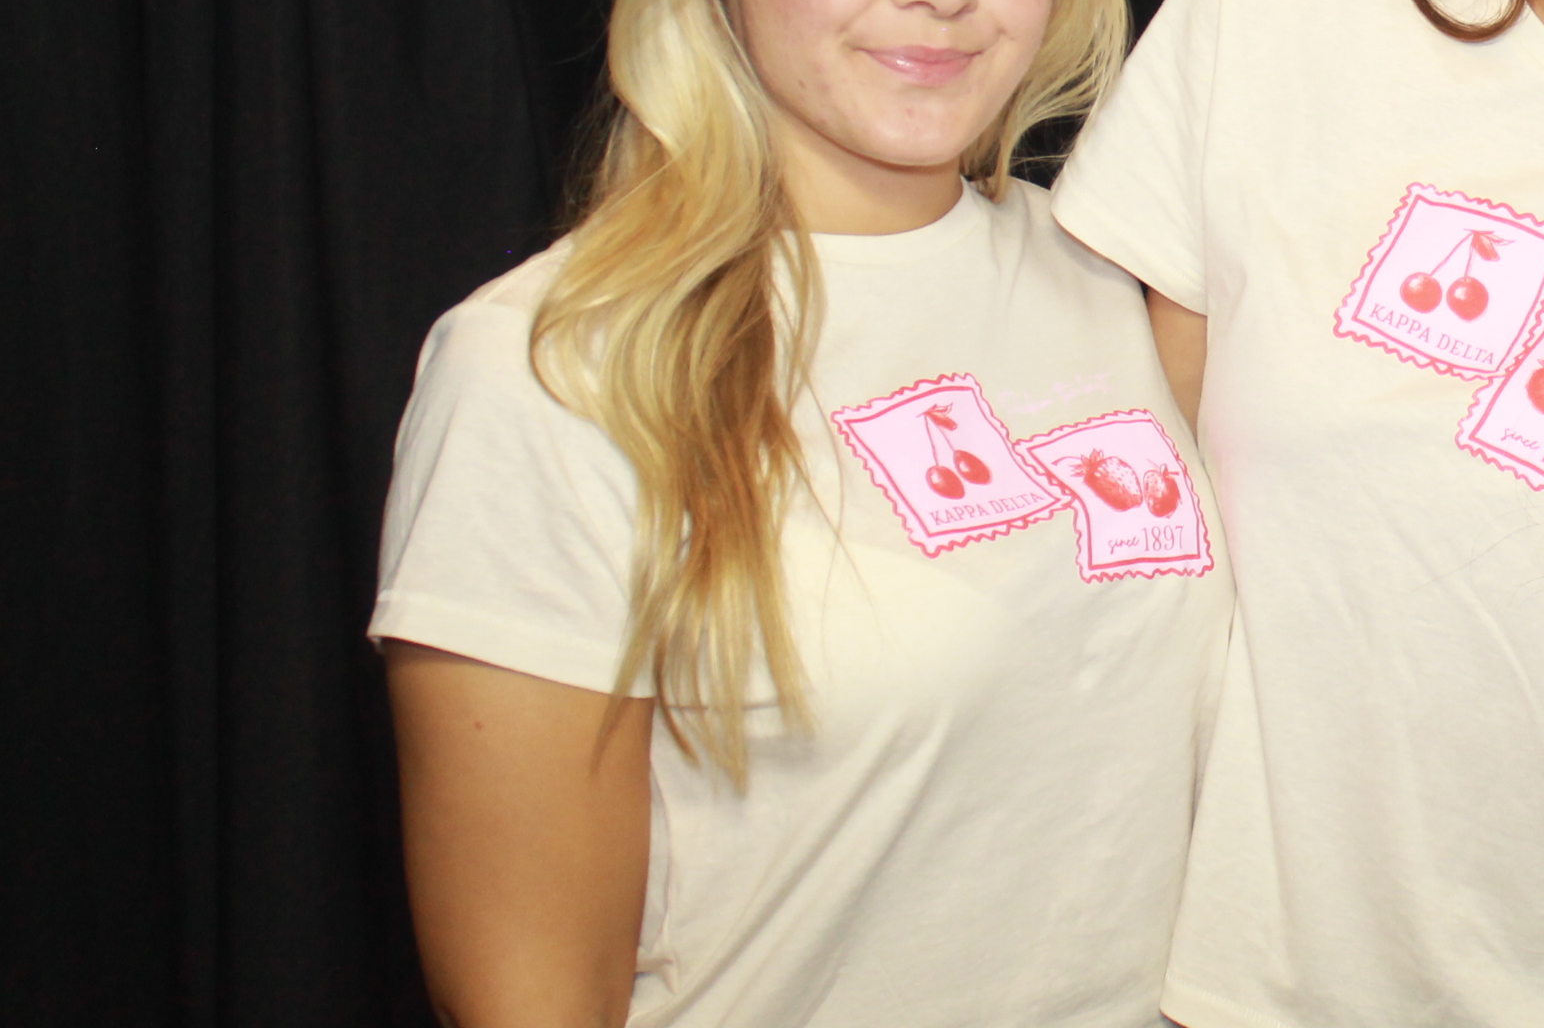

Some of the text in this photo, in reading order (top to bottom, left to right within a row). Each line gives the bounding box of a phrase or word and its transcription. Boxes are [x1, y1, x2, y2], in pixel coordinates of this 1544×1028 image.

[1369, 303, 1497, 365] KAPPA DELTA
[1500, 428, 1540, 450] since
[928, 492, 1045, 526] KAPPA DELTA
[1108, 525, 1184, 555] since 1897
